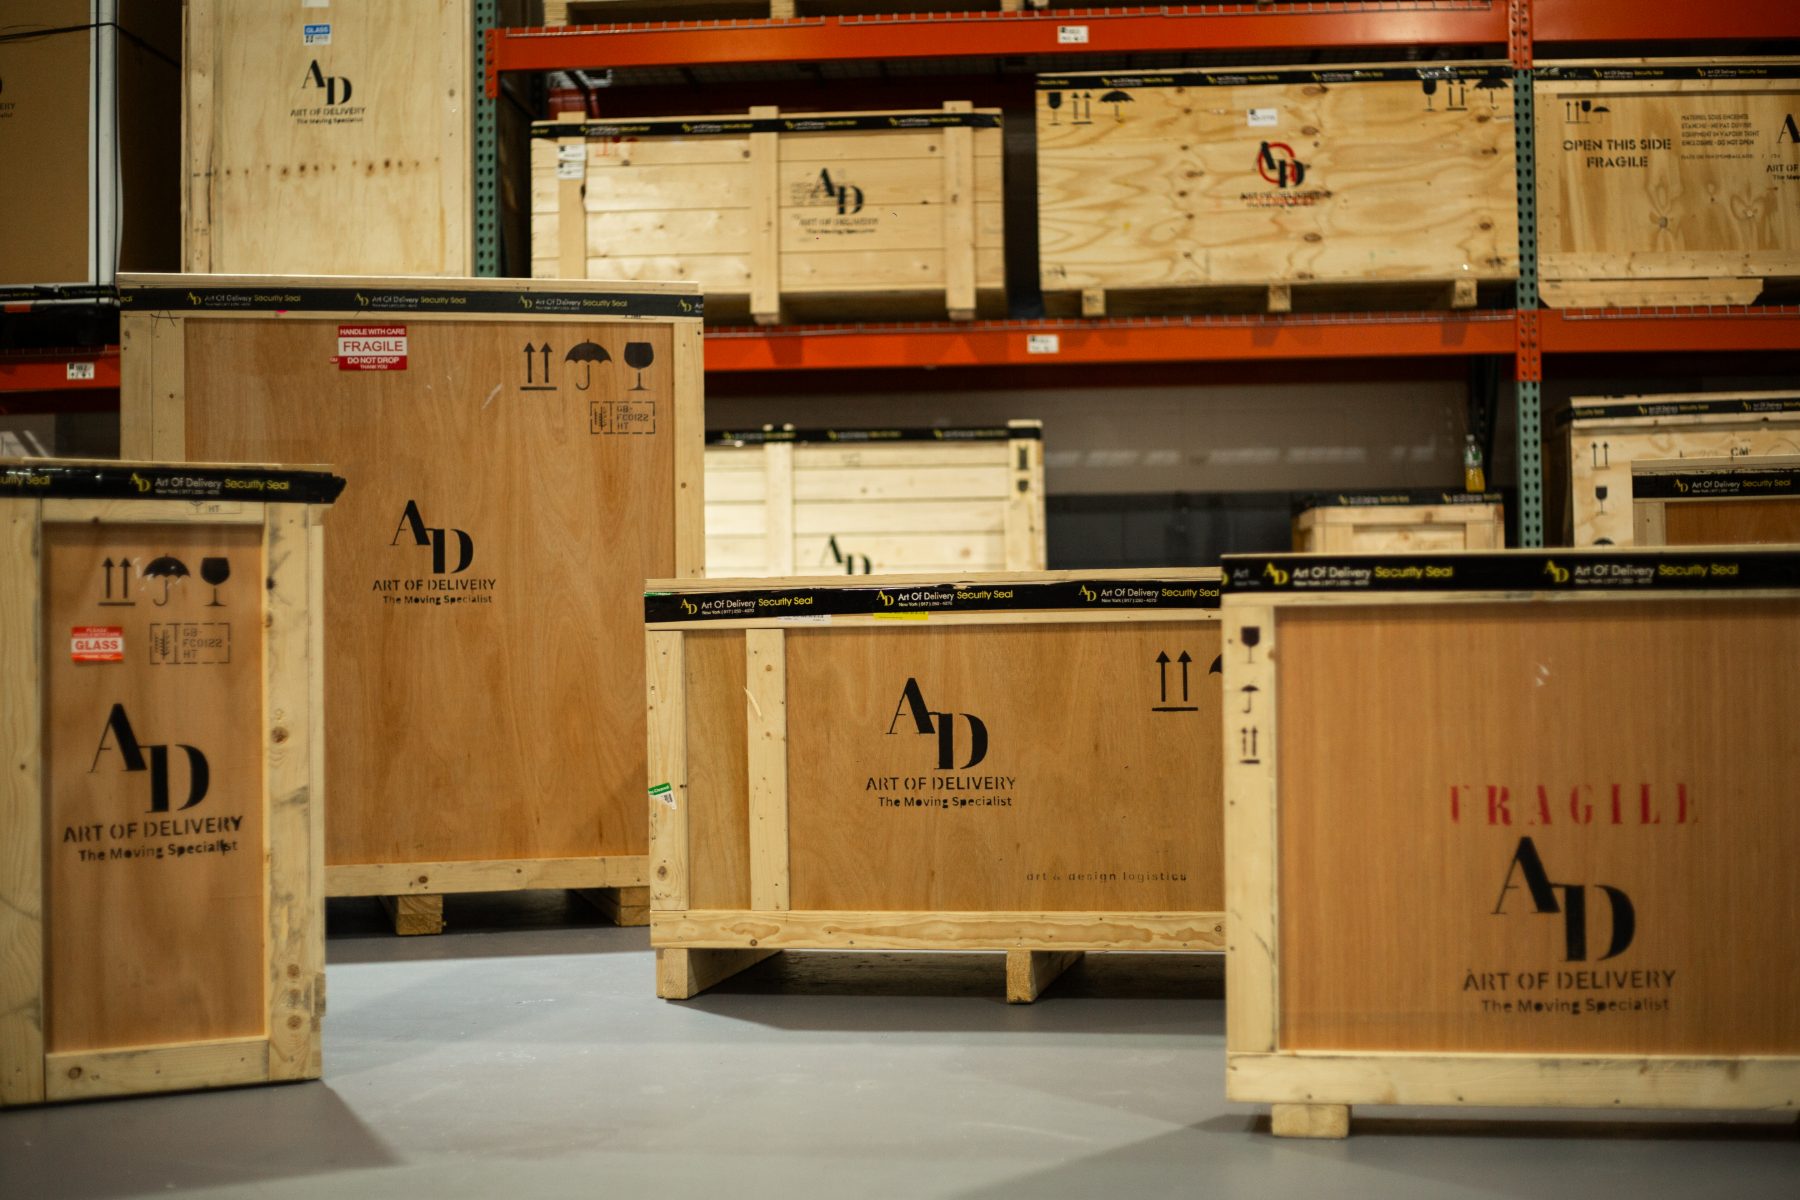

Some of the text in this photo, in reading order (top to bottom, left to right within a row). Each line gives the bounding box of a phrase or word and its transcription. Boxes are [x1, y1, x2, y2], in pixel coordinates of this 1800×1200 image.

[302, 59, 352, 106] AD
[1562, 138, 1672, 151] OPEN THIS SIDE
[1586, 156, 1649, 168] FRAGILE
[1766, 164, 1784, 173] ART
[340, 328, 367, 336] HANDLE
[343, 341, 403, 352] FRAGILE
[129, 472, 150, 492] AD
[155, 477, 169, 487] Art
[170, 477, 184, 487] Of
[185, 477, 222, 489] Delivery
[224, 478, 266, 491] Security
[267, 479, 289, 490] Seal
[1674, 479, 1689, 493] AD
[1703, 480, 1712, 488] Of
[1714, 480, 1740, 489] Delivery
[1742, 480, 1772, 488] Security
[1774, 479, 1791, 487] Seal
[389, 500, 474, 574] AD
[1263, 562, 1289, 585] AD
[1292, 567, 1309, 578] Art
[1312, 566, 1327, 578] Of
[1329, 566, 1371, 580] Delivery
[1375, 566, 1423, 579] Security
[1426, 566, 1453, 577] Seal
[1544, 560, 1569, 583] AD
[1575, 566, 1591, 576] Art
[1594, 565, 1609, 576] Of
[1612, 565, 1655, 578] Delivery
[1659, 564, 1708, 577] Security
[1711, 563, 1739, 575] Seal
[372, 579, 497, 591] ART OF DELIVERY
[1079, 585, 1219, 602] AD Art Of Delivery Security Seal
[383, 595, 493, 605] The Moving Specialist
[680, 596, 813, 615] AD Art Of Delivery Security Seal
[876, 590, 1014, 607] AD Art Of Delivery Security Seal
[75, 640, 119, 650] GLASS
[885, 678, 989, 770] AD
[87, 703, 210, 814] AD
[866, 776, 1016, 791] ART OF DELIVERY
[878, 796, 1012, 809] The Moving Specialist
[63, 815, 243, 843] ART OF DELIVERY
[79, 839, 238, 862] The Moving Specialist
[1026, 872, 1047, 881] art
[1068, 872, 1116, 882] design
[1122, 872, 1187, 883] logistics
[1490, 835, 1636, 962] AD
[1462, 969, 1677, 991] ART OF DELIVERY
[1482, 997, 1669, 1015] The Moving Specialist
